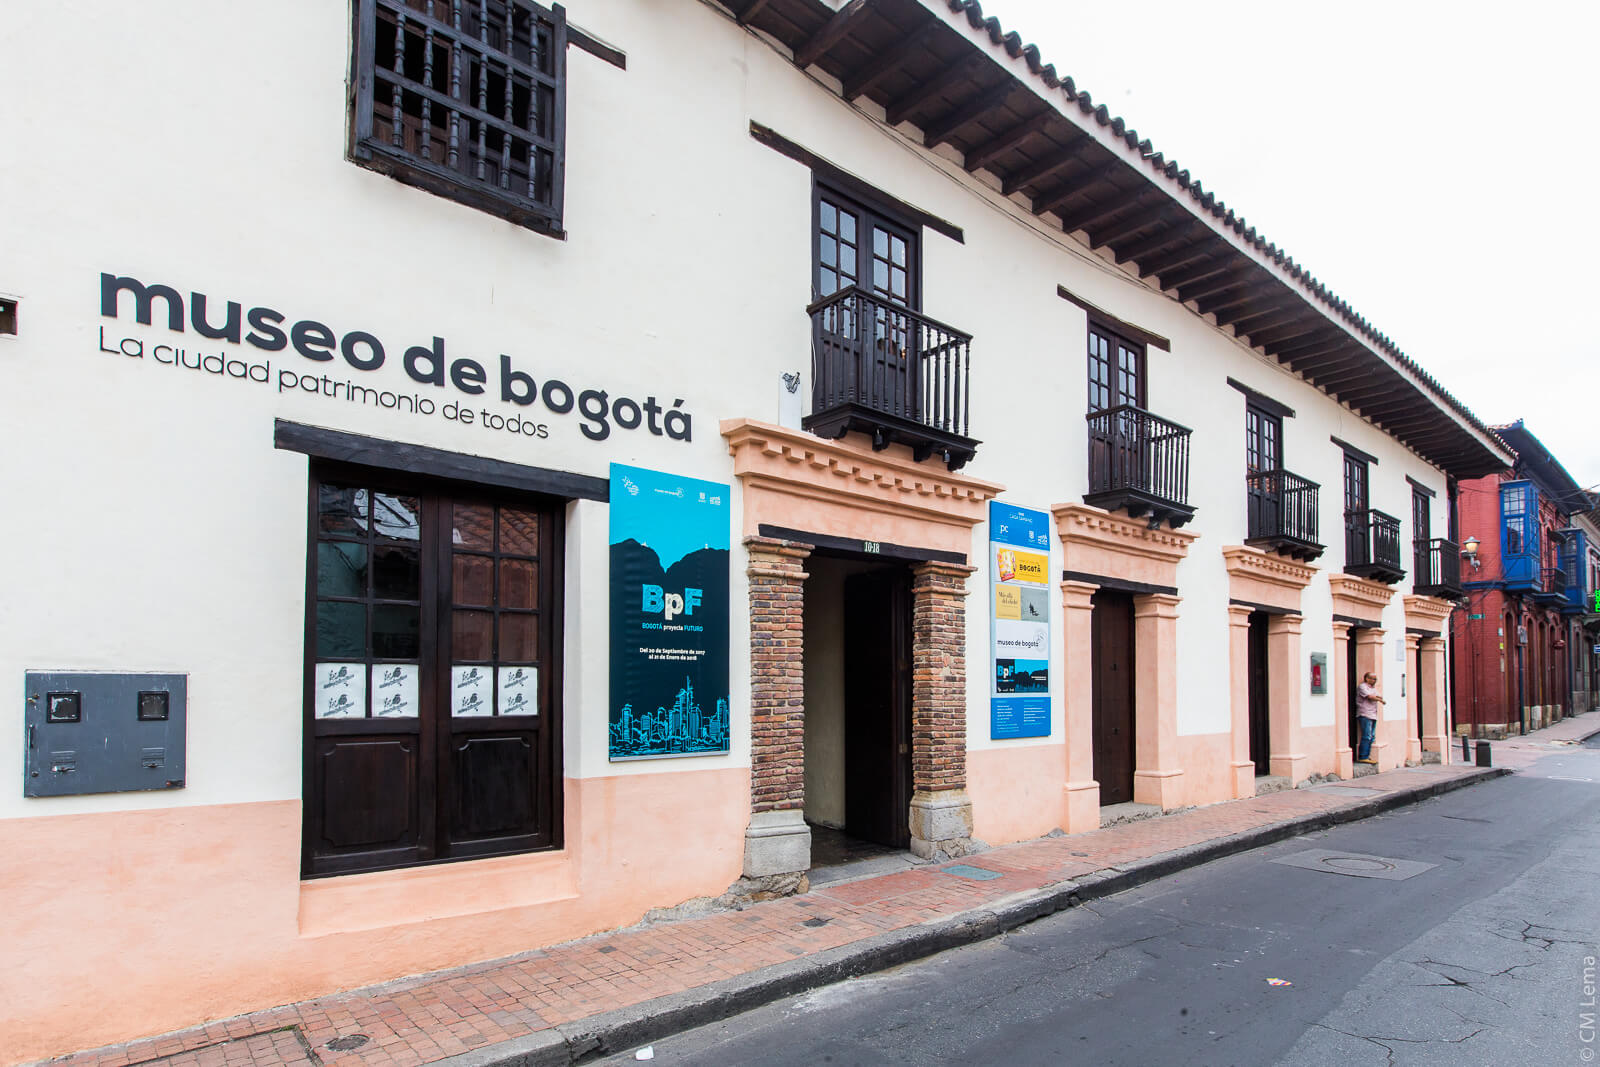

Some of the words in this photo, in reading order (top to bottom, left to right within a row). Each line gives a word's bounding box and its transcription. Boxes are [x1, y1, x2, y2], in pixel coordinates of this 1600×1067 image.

[100, 272, 386, 372] museo
[403, 336, 487, 396] de
[500, 354, 692, 443] bogotá
[99, 325, 144, 359] La
[153, 344, 270, 384] ciudad
[278, 369, 436, 415] patrimonio
[442, 400, 475, 425] de
[480, 408, 549, 439] todos
[864, 541, 880, 554] 10-18
[642, 583, 703, 621] BpF
[641, 622, 663, 630] BOGOTÁ
[684, 624, 704, 632] FUTURO
[997, 664, 1014, 679] BpF
